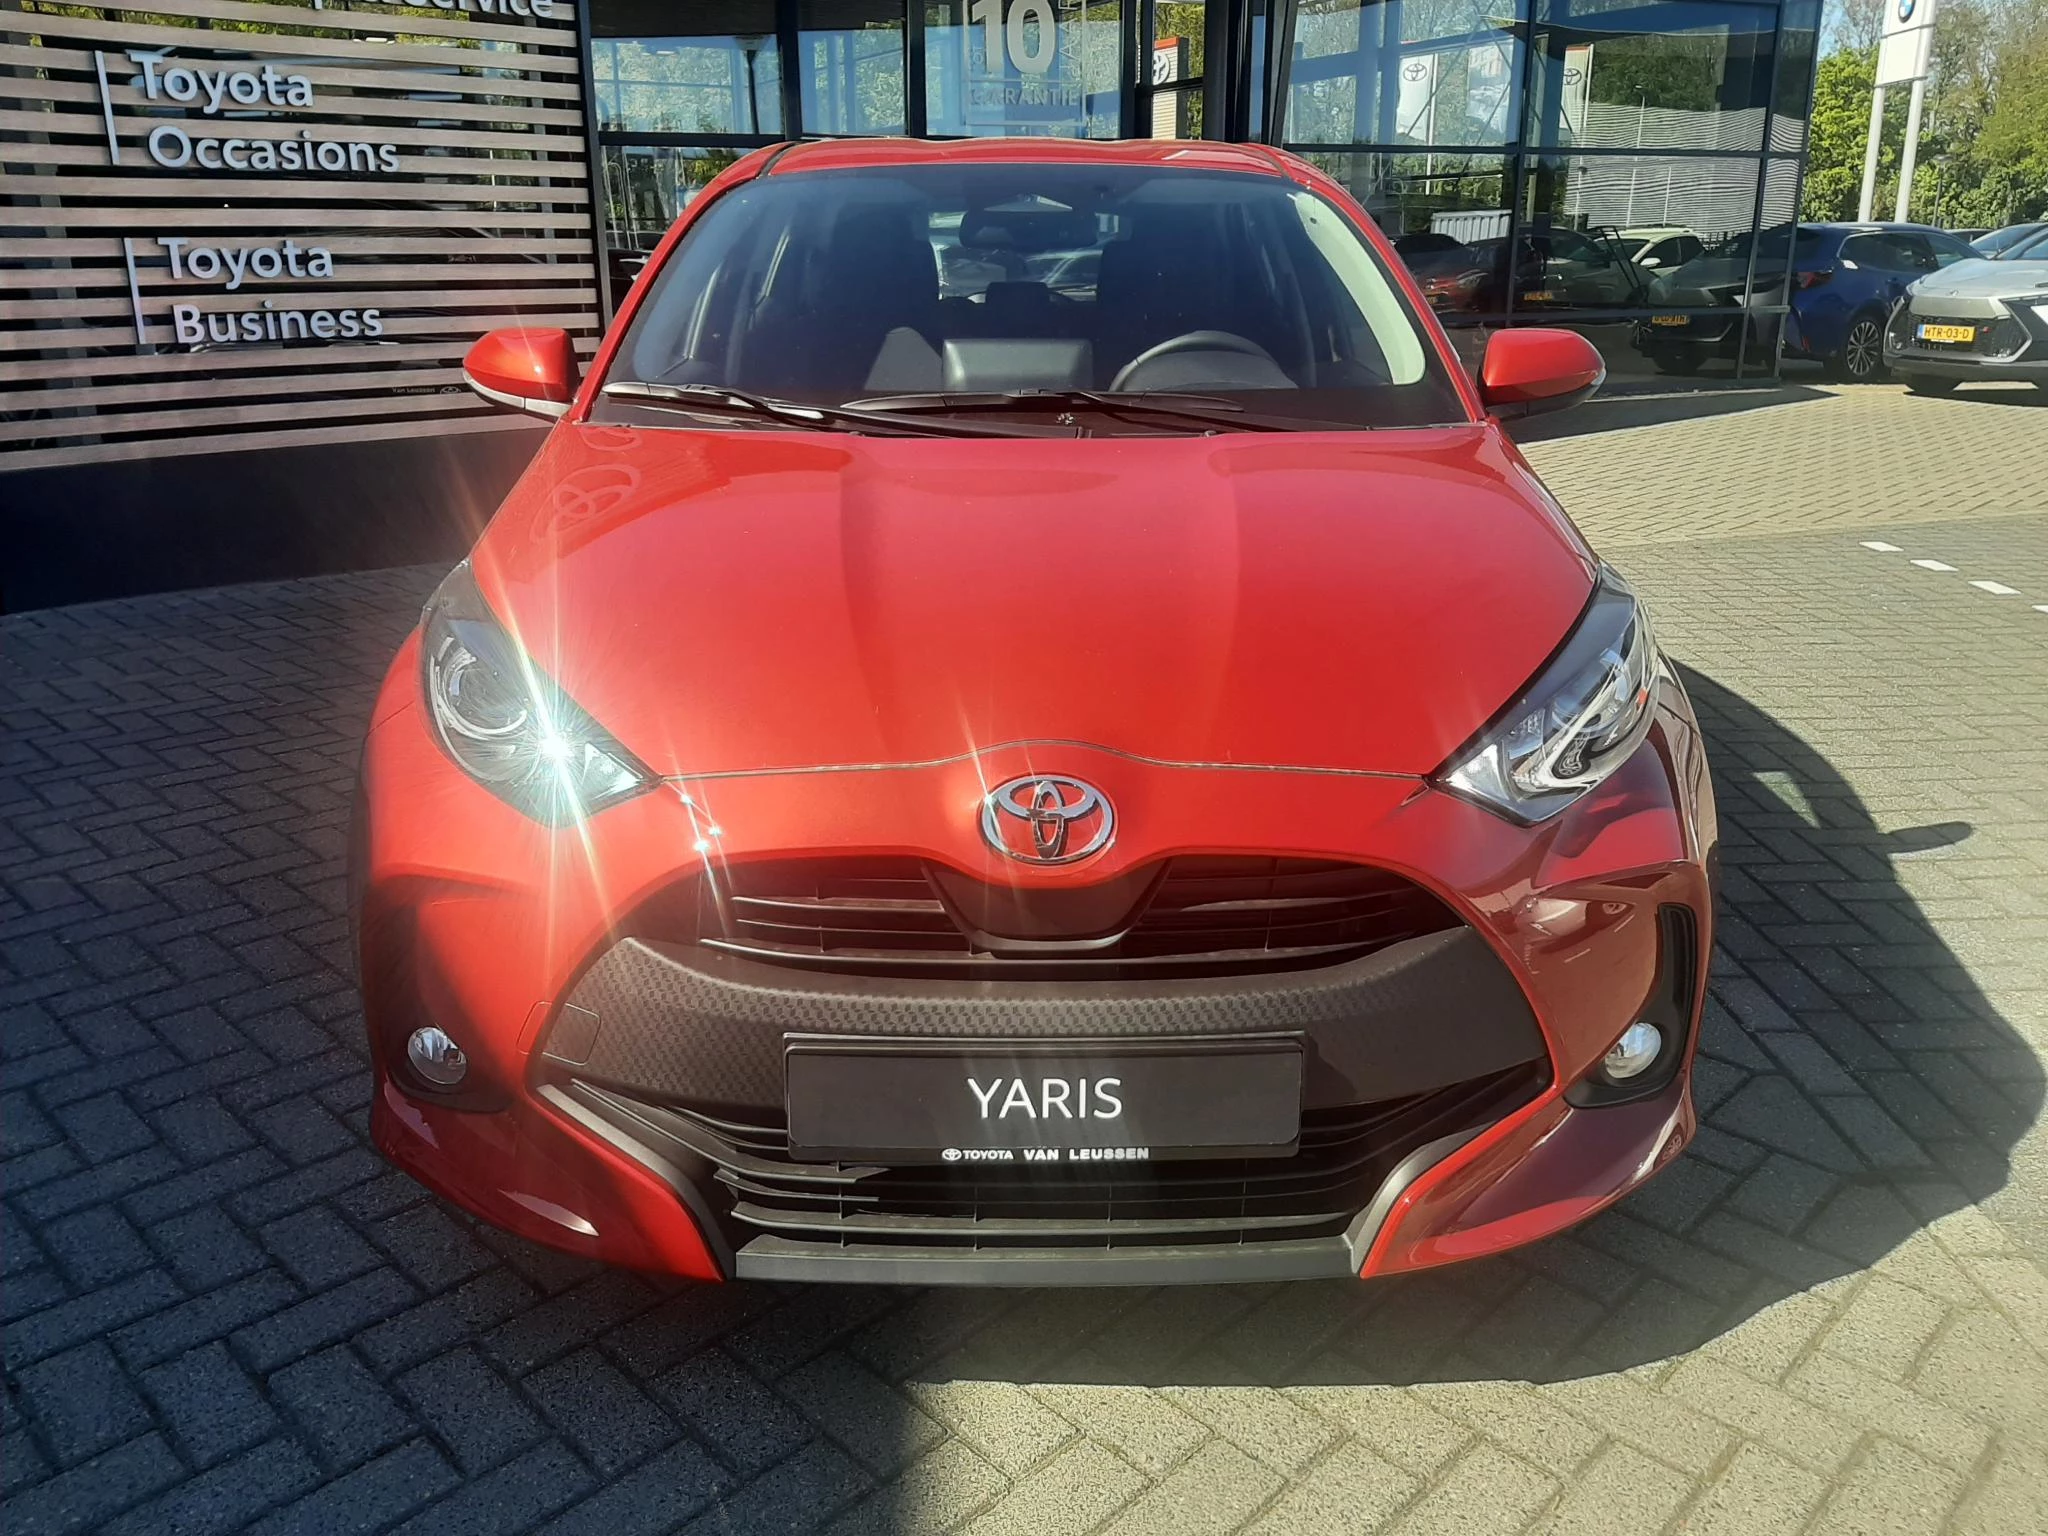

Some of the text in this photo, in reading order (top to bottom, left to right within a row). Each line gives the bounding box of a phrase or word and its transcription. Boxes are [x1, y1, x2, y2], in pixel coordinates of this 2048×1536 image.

[972, 0, 1055, 74] 10
[129, 52, 314, 115] Toyota
[148, 124, 401, 173] Occasions
[156, 236, 335, 290] Toyota
[172, 299, 384, 344] Business
[1923, 326, 1970, 339] HTR-03-D
[967, 1077, 1123, 1120] YARIS
[962, 1147, 1150, 1161] TOYOTA VAN LEUSSEN
